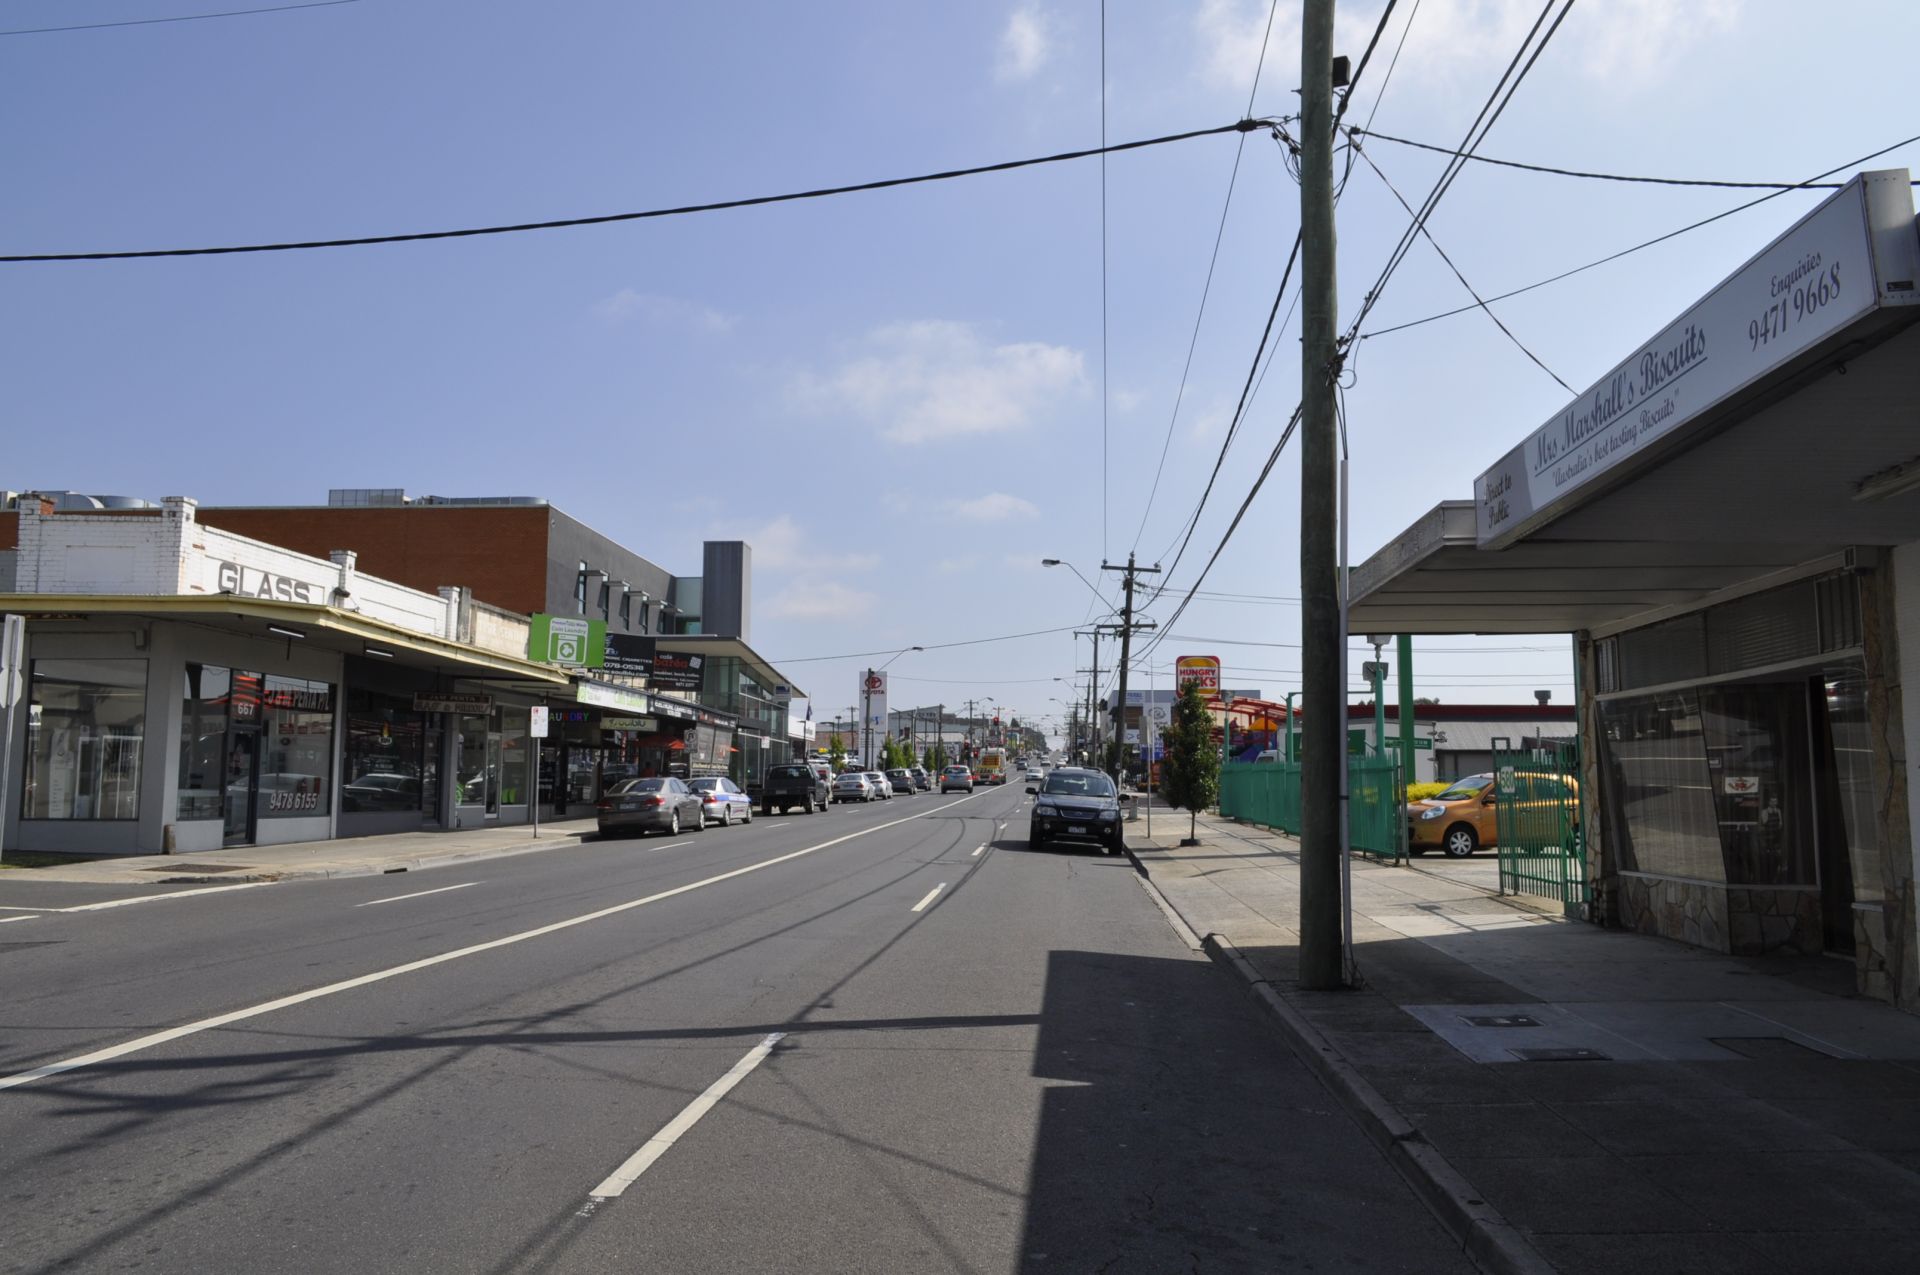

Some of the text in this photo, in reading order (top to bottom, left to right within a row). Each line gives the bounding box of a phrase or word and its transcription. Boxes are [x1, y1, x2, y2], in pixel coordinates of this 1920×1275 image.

[1771, 252, 1821, 297] Enquiries
[1749, 261, 1840, 352] 9471 9668
[1534, 324, 1706, 470] Mrs Marshall's Biscuits
[1594, 443, 1608, 463] best
[1609, 423, 1637, 446] tasting
[1484, 472, 1512, 505] Direct to
[1488, 499, 1510, 528] Public
[218, 561, 310, 603] GLASS
[1179, 668, 1216, 677] HUNGRY
[238, 703, 254, 715] 667
[548, 711, 590, 722] AUNDRY
[270, 792, 318, 810] 9478 6155
